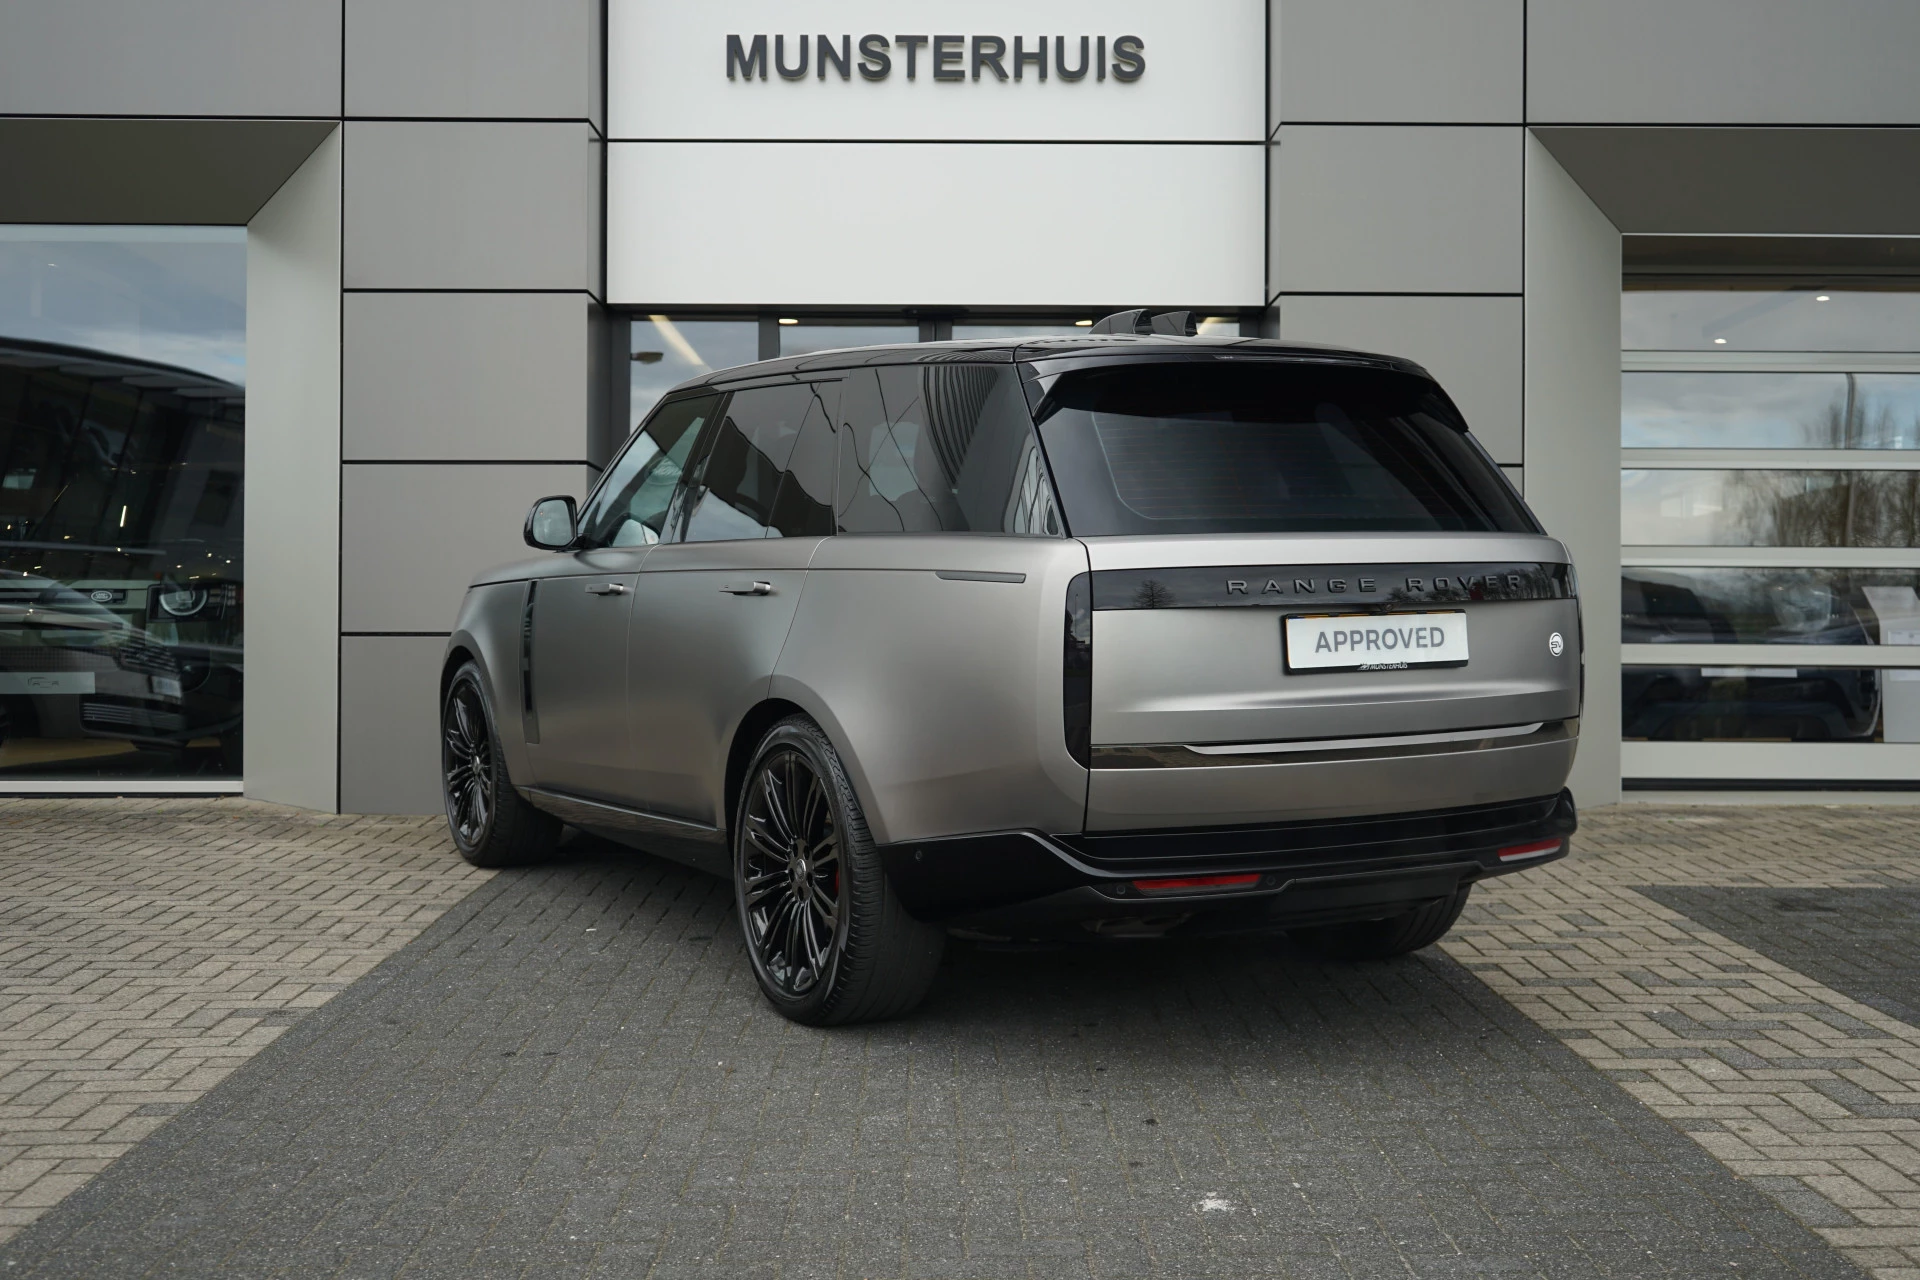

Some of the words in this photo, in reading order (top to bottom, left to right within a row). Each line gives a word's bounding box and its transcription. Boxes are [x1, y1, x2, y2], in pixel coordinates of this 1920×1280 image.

[726, 34, 1146, 82] MUNSTERHUIS
[1226, 578, 1377, 595] RANGE
[1405, 575, 1521, 592] ROVER
[1315, 626, 1445, 653] APPROVED
